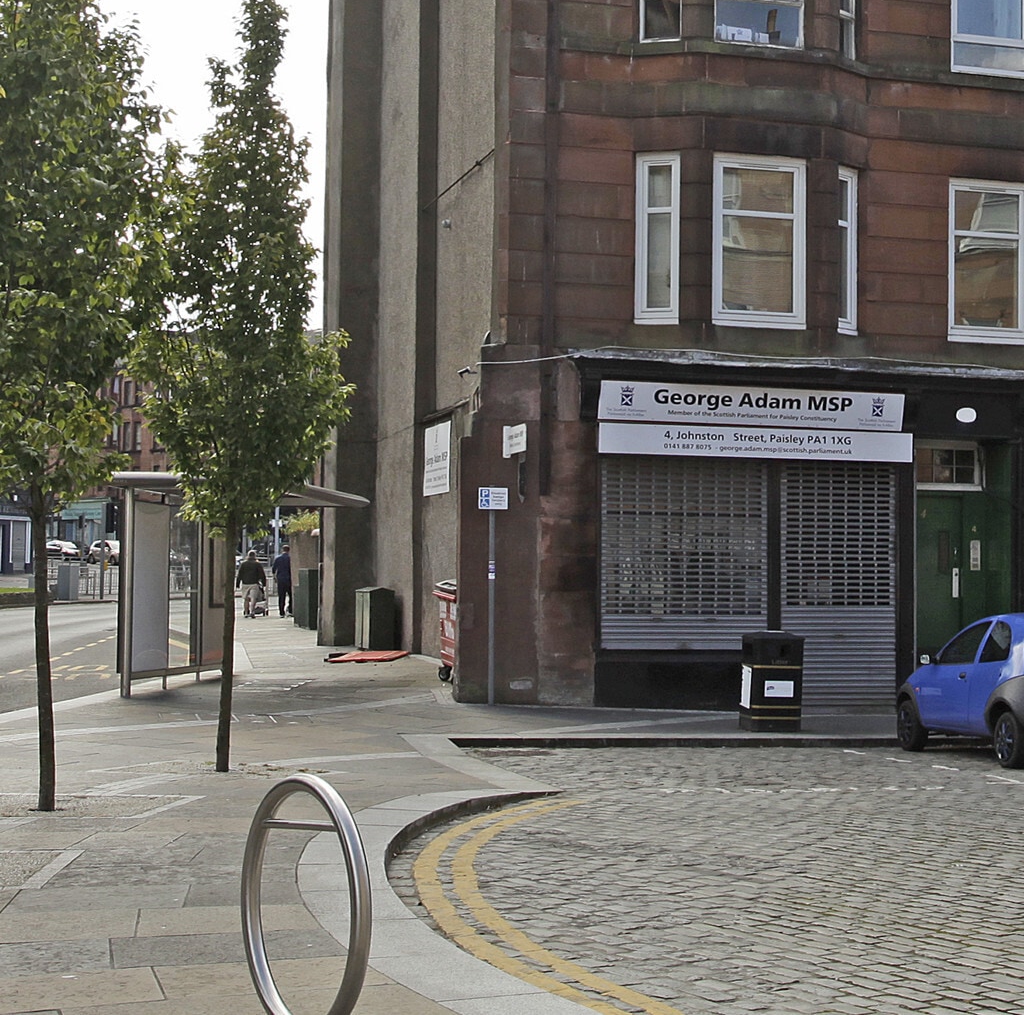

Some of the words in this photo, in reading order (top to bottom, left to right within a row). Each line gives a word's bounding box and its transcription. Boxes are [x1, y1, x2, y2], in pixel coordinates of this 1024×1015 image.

[654, 389, 732, 410] George
[739, 393, 801, 410] Adam
[808, 396, 853, 412] MSP
[738, 412, 768, 420] Parliament
[779, 414, 799, 422] Paisley
[800, 415, 837, 423] Constituency
[664, 431, 674, 441] 4,
[676, 431, 724, 441] Johnston
[733, 433, 767, 444] Street,
[770, 434, 805, 446] Paisley
[808, 435, 827, 445] PA1
[832, 436, 852, 445] 1XG
